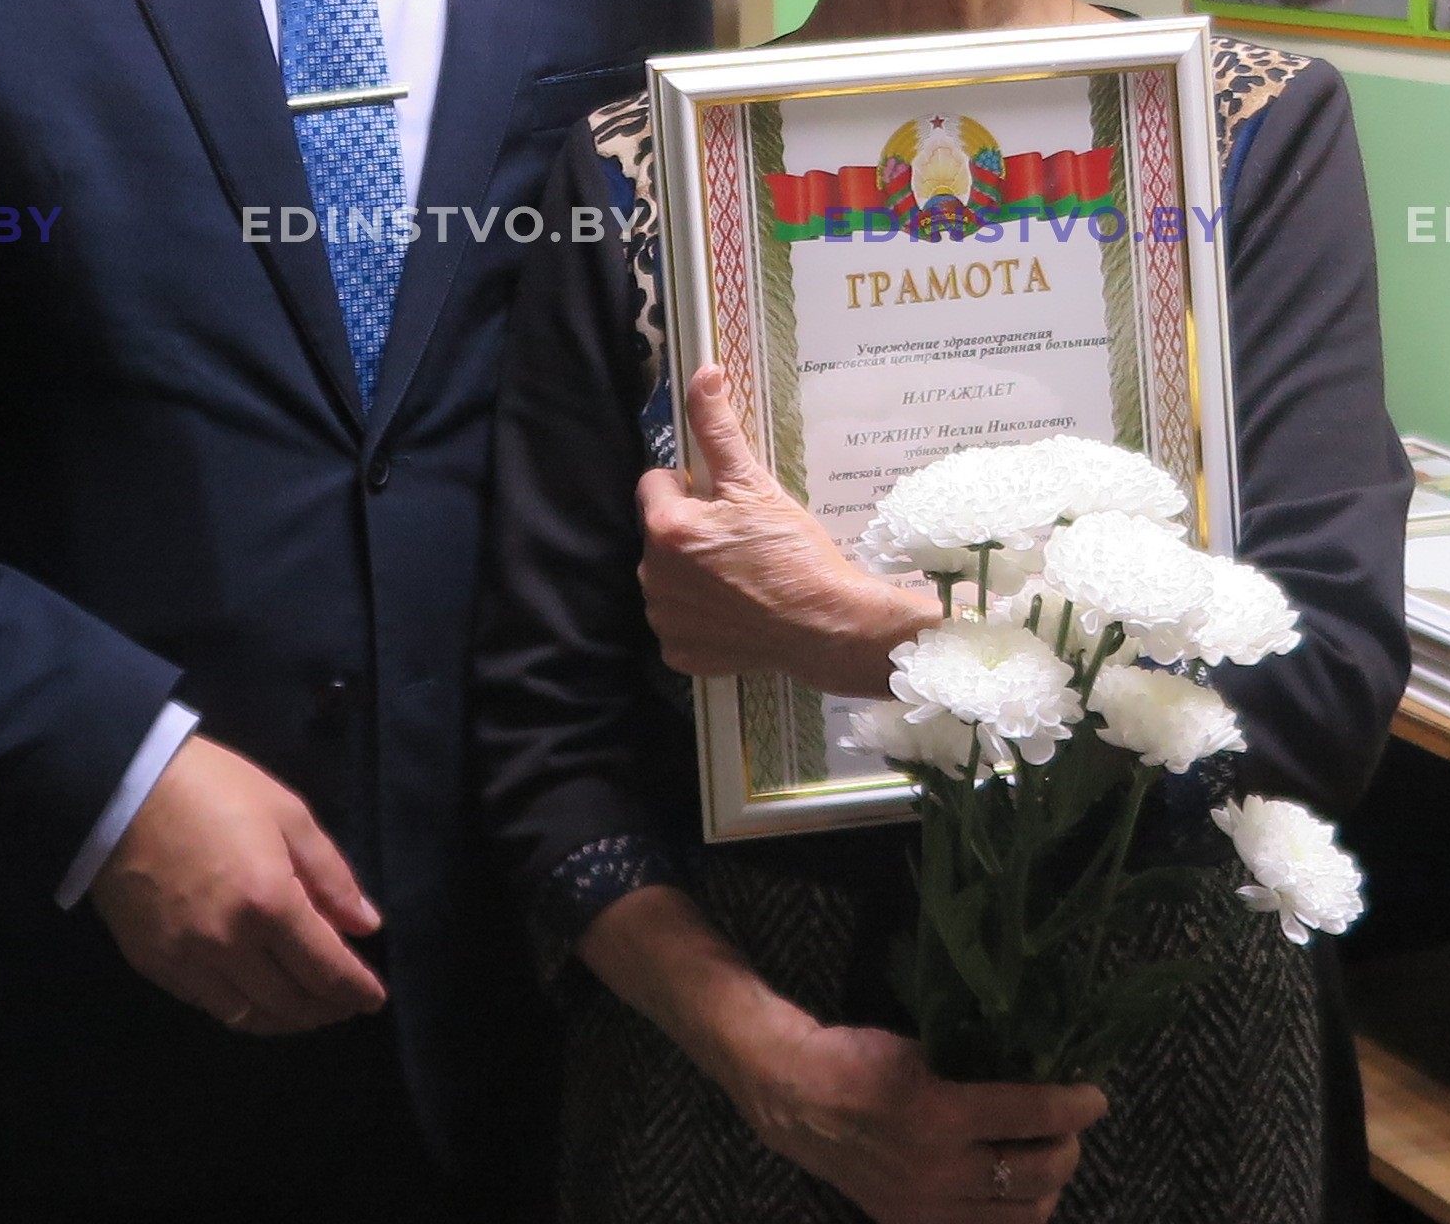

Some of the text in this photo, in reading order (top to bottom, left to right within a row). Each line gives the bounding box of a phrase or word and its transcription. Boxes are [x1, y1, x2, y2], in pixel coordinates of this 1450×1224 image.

[845, 256, 1052, 310] ГРАМОТА
[857, 330, 1053, 356] Учреждение здравоохранения
[890, 348, 976, 365] центральная
[979, 342, 1041, 359] районная
[902, 382, 1015, 405] НАГРАЖДАЕТ
[844, 415, 1077, 447] МУРЖИНУ Нелли Николаевну,
[903, 442, 950, 461] зубного
[829, 466, 882, 482] детской
[871, 484, 894, 497] учр
[816, 502, 877, 517] «Борисов
